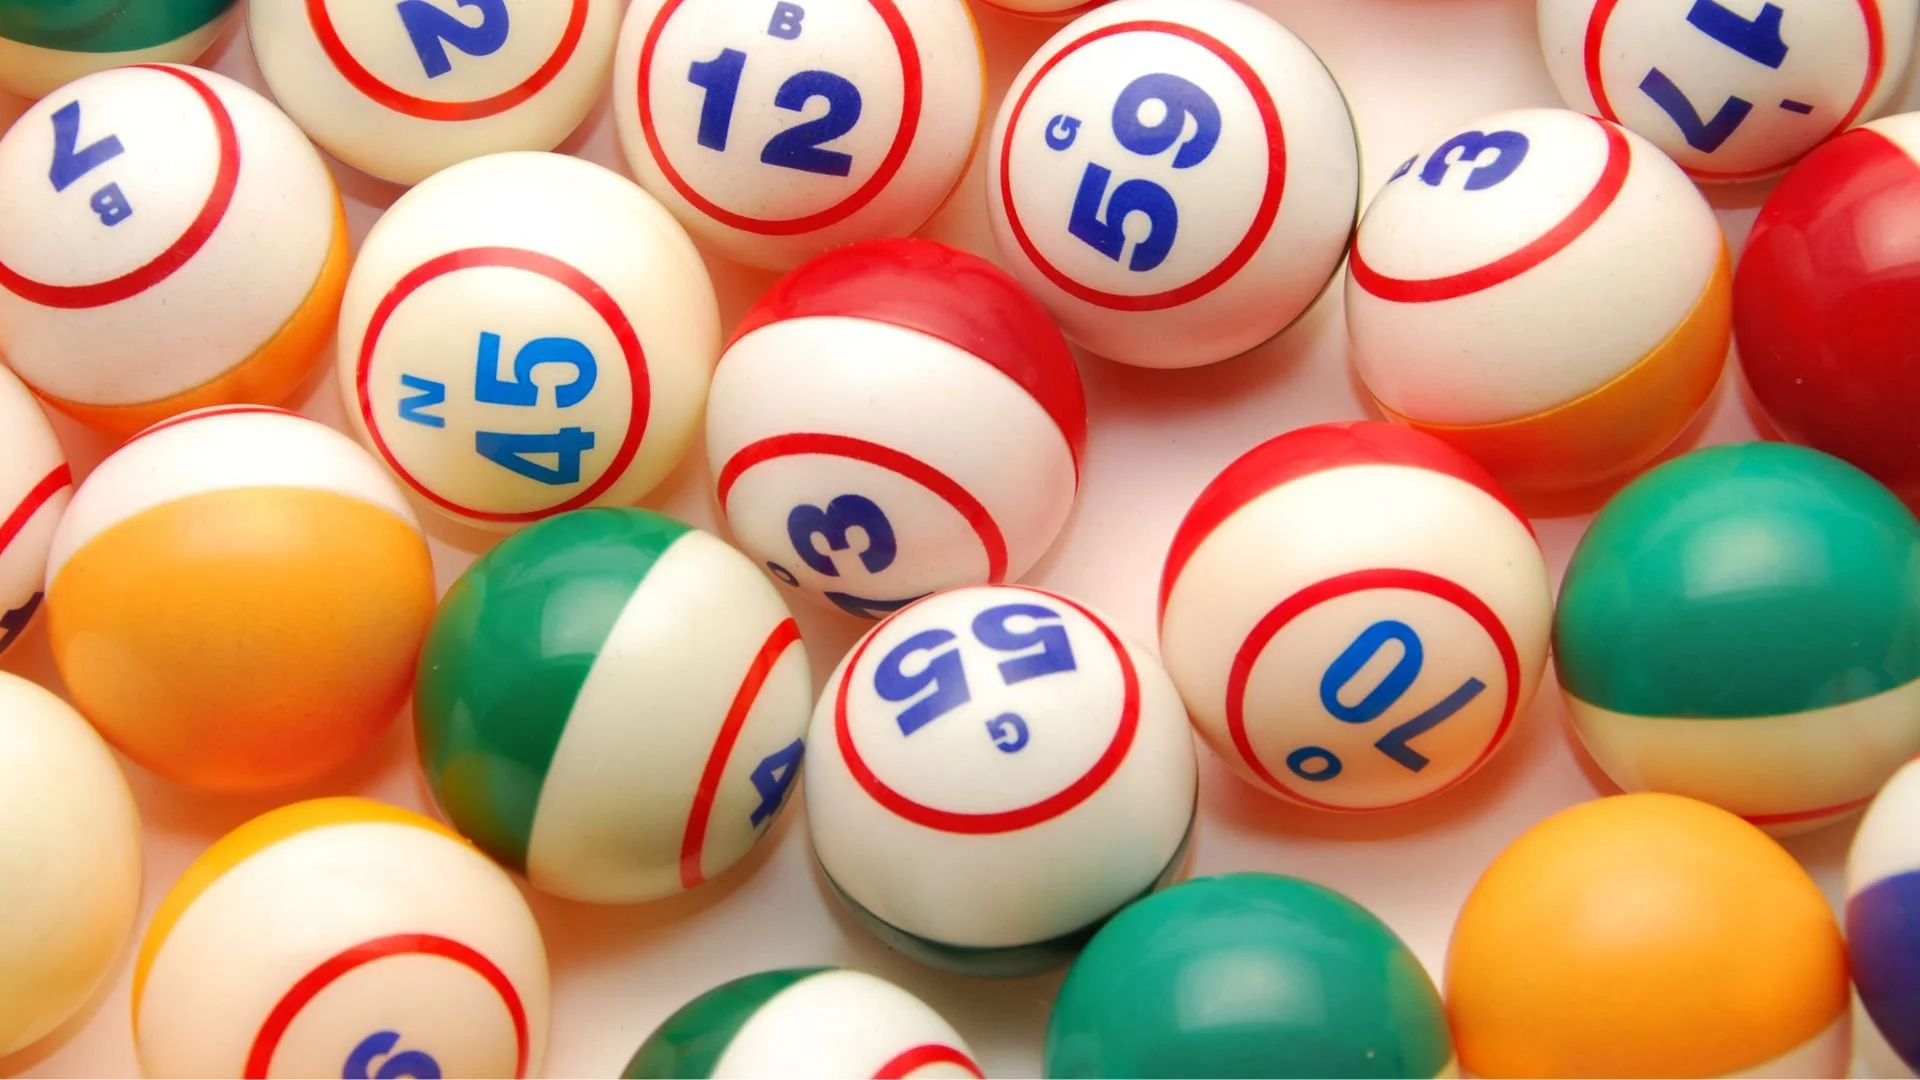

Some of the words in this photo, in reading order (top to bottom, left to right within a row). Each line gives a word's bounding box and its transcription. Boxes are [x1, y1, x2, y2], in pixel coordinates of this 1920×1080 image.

[766, 1, 805, 41] B
[49, 100, 125, 193] 7
[687, 47, 863, 178] 12
[1044, 113, 1082, 151] G
[1067, 72, 1222, 272] 59
[1417, 130, 1530, 191] 3
[90, 182, 133, 227] B
[399, 374, 446, 428] N
[474, 331, 599, 485] 45
[873, 602, 1078, 737] 55
[1320, 619, 1488, 774] 70
[985, 711, 1030, 753] G
